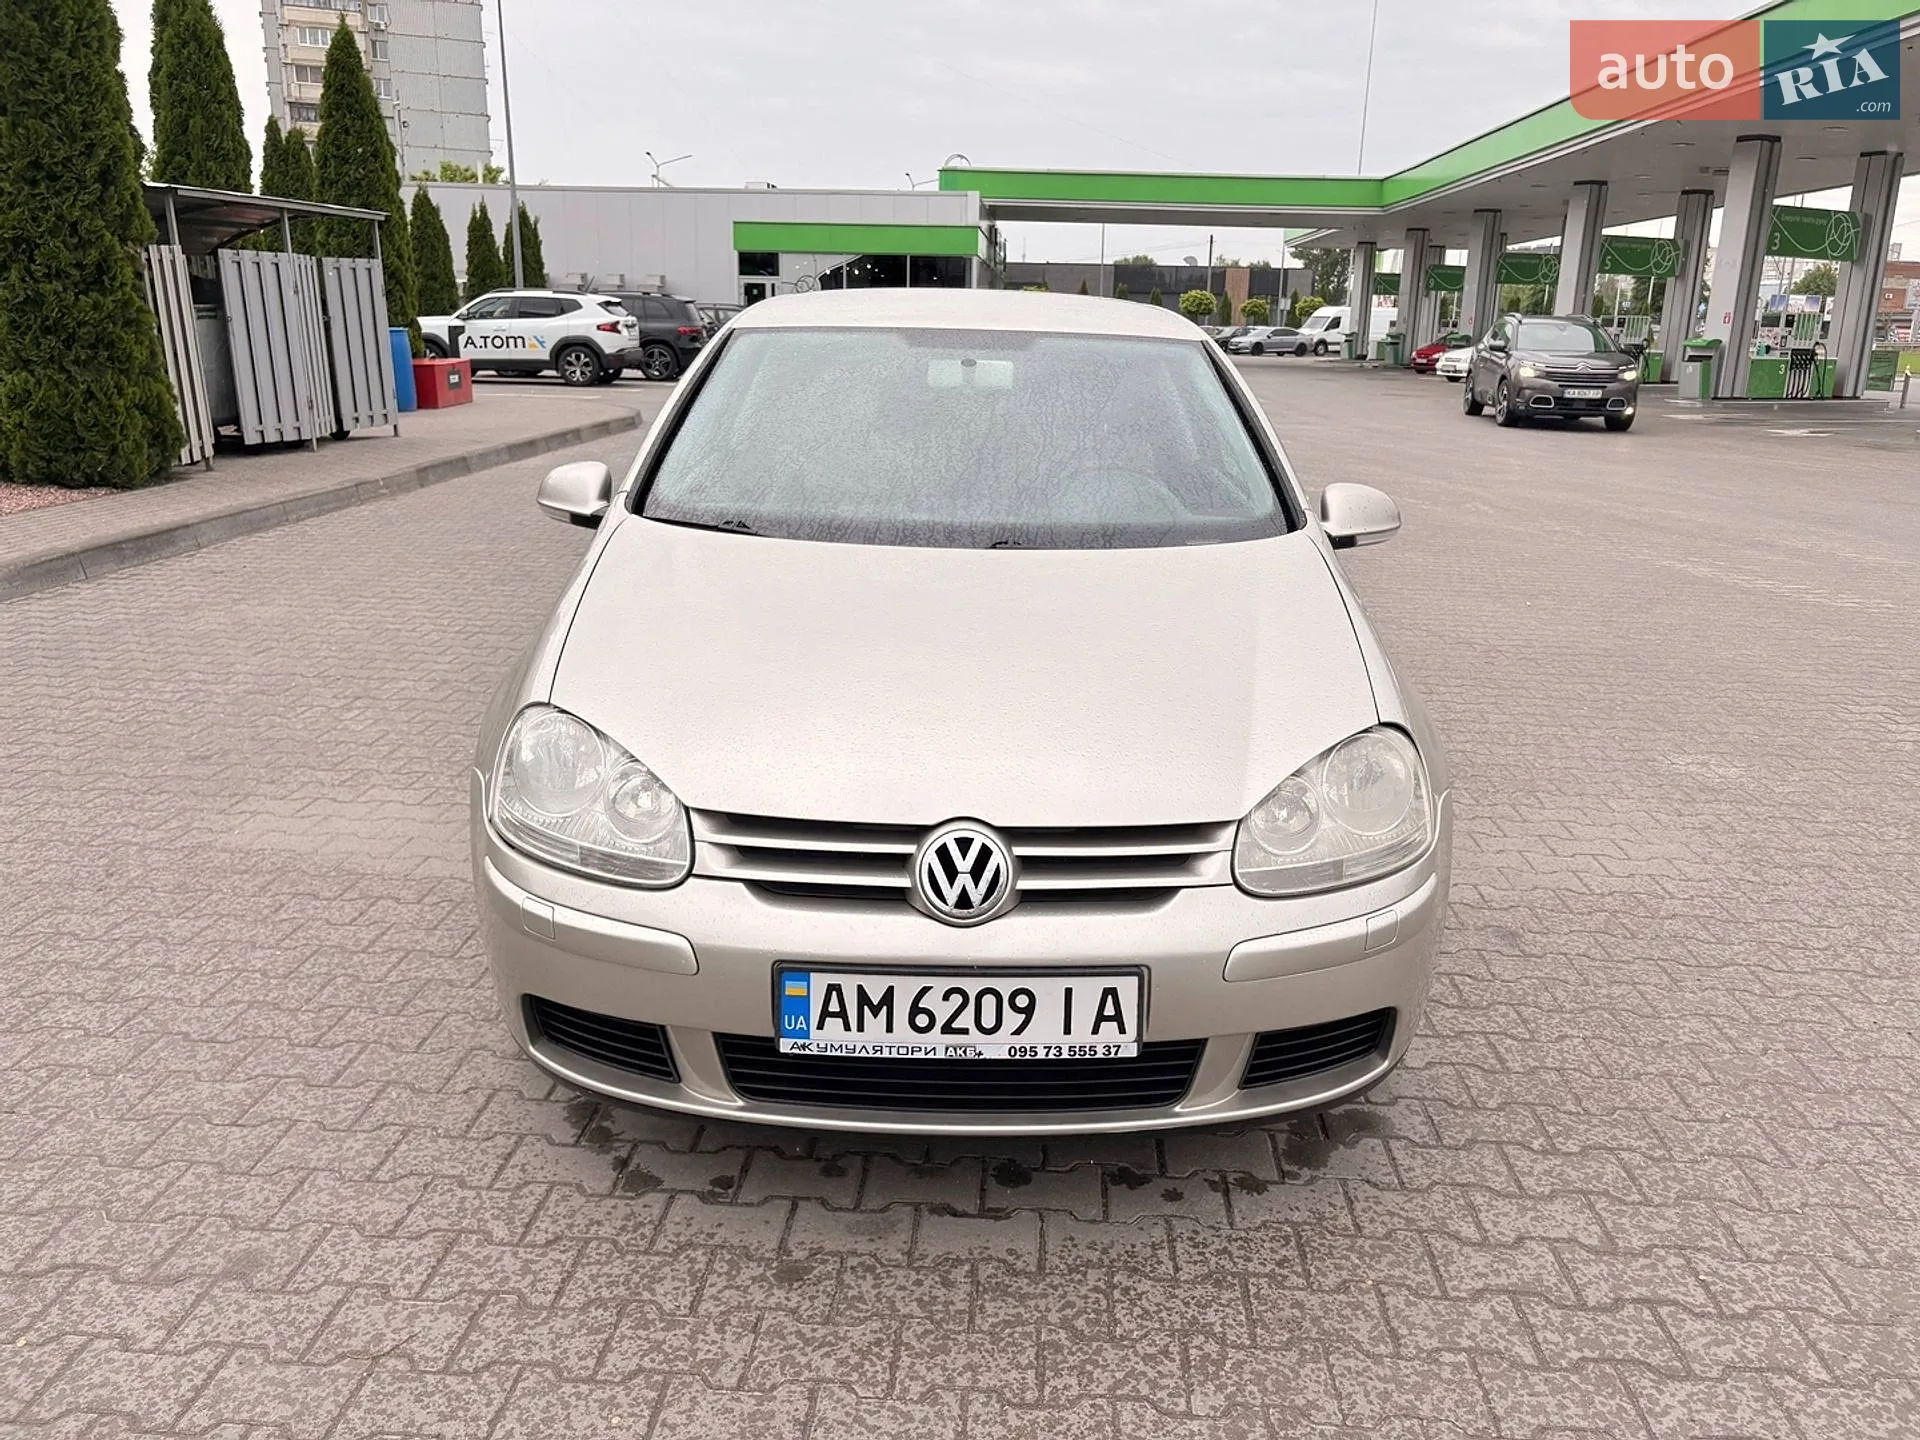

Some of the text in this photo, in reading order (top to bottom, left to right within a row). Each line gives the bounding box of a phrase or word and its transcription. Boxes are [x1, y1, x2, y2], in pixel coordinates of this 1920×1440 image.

[1771, 231, 1780, 250] 3
[1603, 255, 1612, 270] 5
[1778, 364, 1786, 375] 3
[816, 983, 1127, 1036] AM 6209 IA
[784, 1014, 807, 1031] UA
[789, 1041, 937, 1057] АКУМУЛЯТОРИ
[1008, 1045, 1038, 1058] 095
[1043, 1045, 1063, 1058] 73
[1067, 1045, 1098, 1057] 555
[1102, 1044, 1122, 1057] 37
